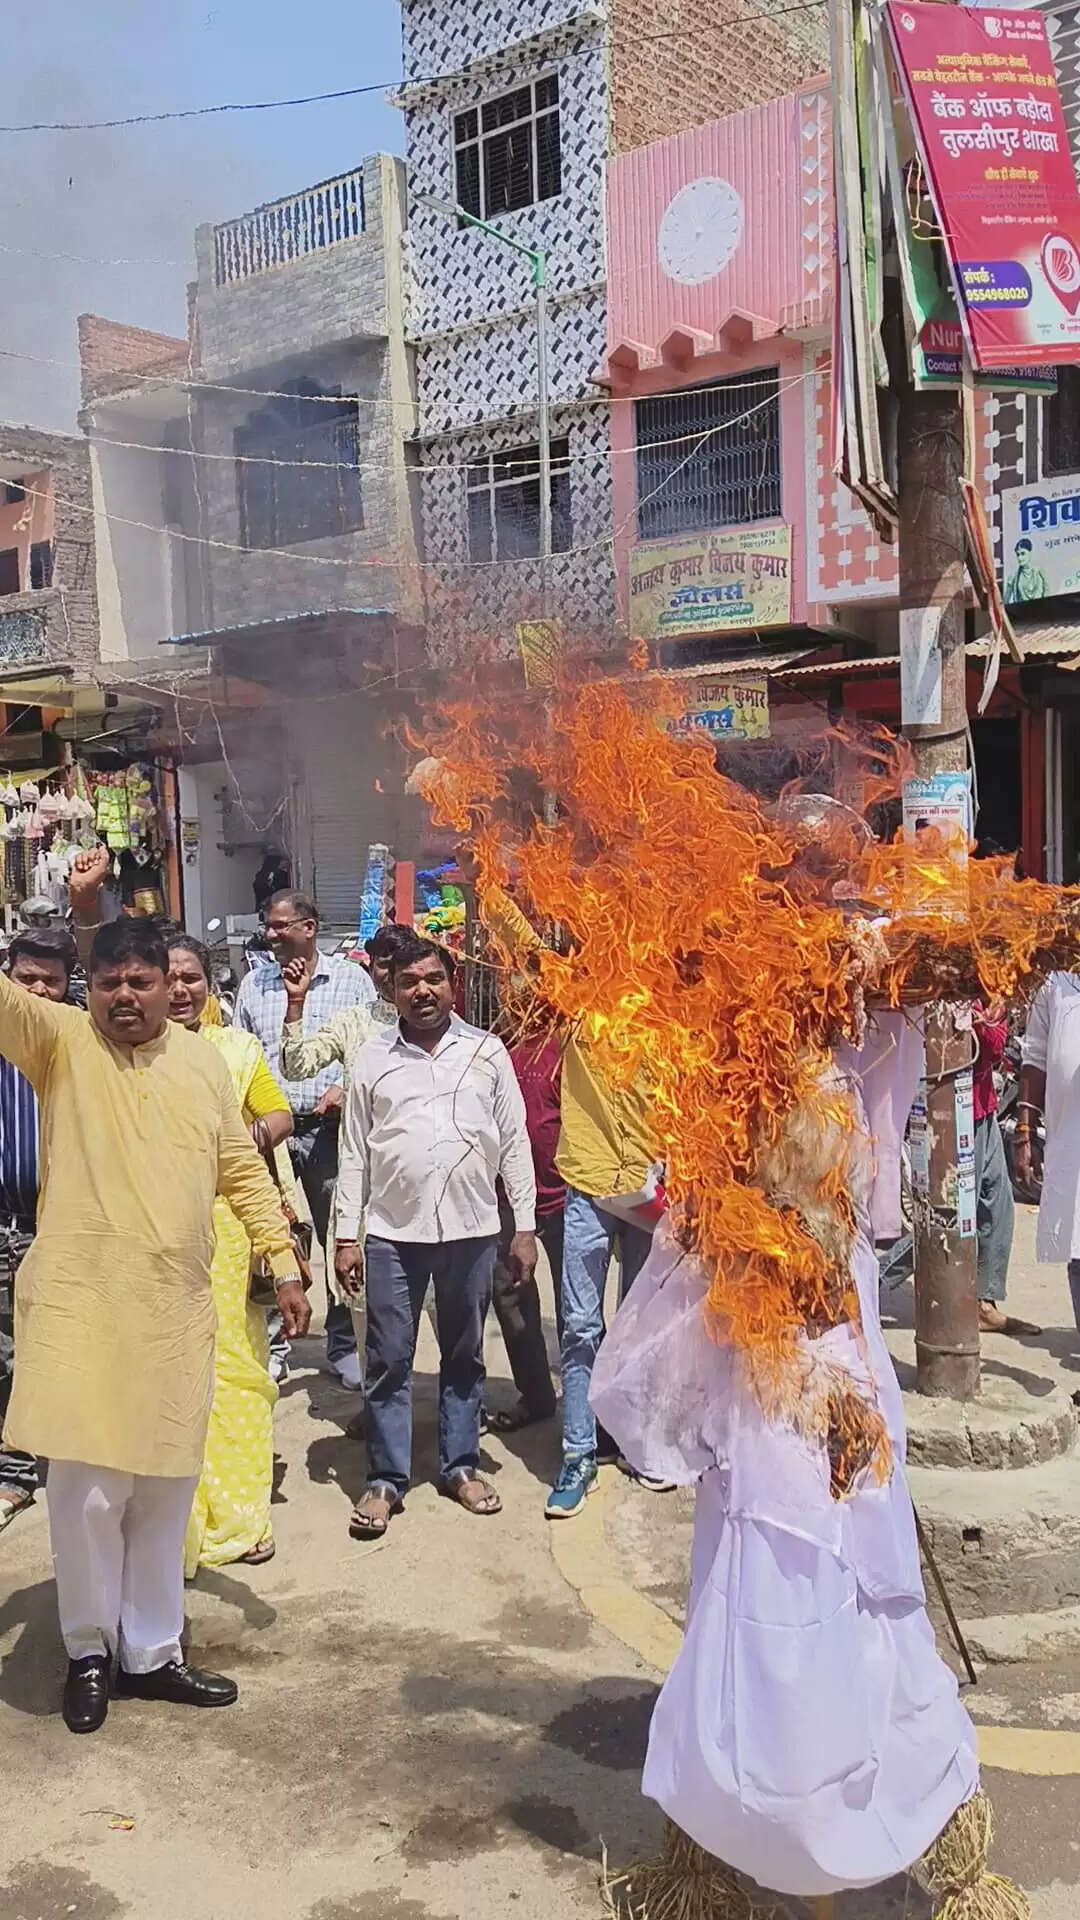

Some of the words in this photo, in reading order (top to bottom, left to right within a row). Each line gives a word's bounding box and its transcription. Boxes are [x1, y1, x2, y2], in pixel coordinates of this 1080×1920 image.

[930, 91, 966, 118] बैंक
[969, 91, 1012, 118] ऑफ
[939, 122, 1020, 158] तुलसीपुर
[1022, 128, 1060, 153] शाखा
[966, 287, 1029, 301] 9554968020
[927, 358, 956, 373] Contact
[631, 564, 667, 596] अजय
[668, 554, 704, 586] कुमार
[708, 548, 747, 574] विजय
[750, 553, 788, 580] कुमार
[696, 680, 731, 703] विजय
[733, 684, 766, 709] कुमार
